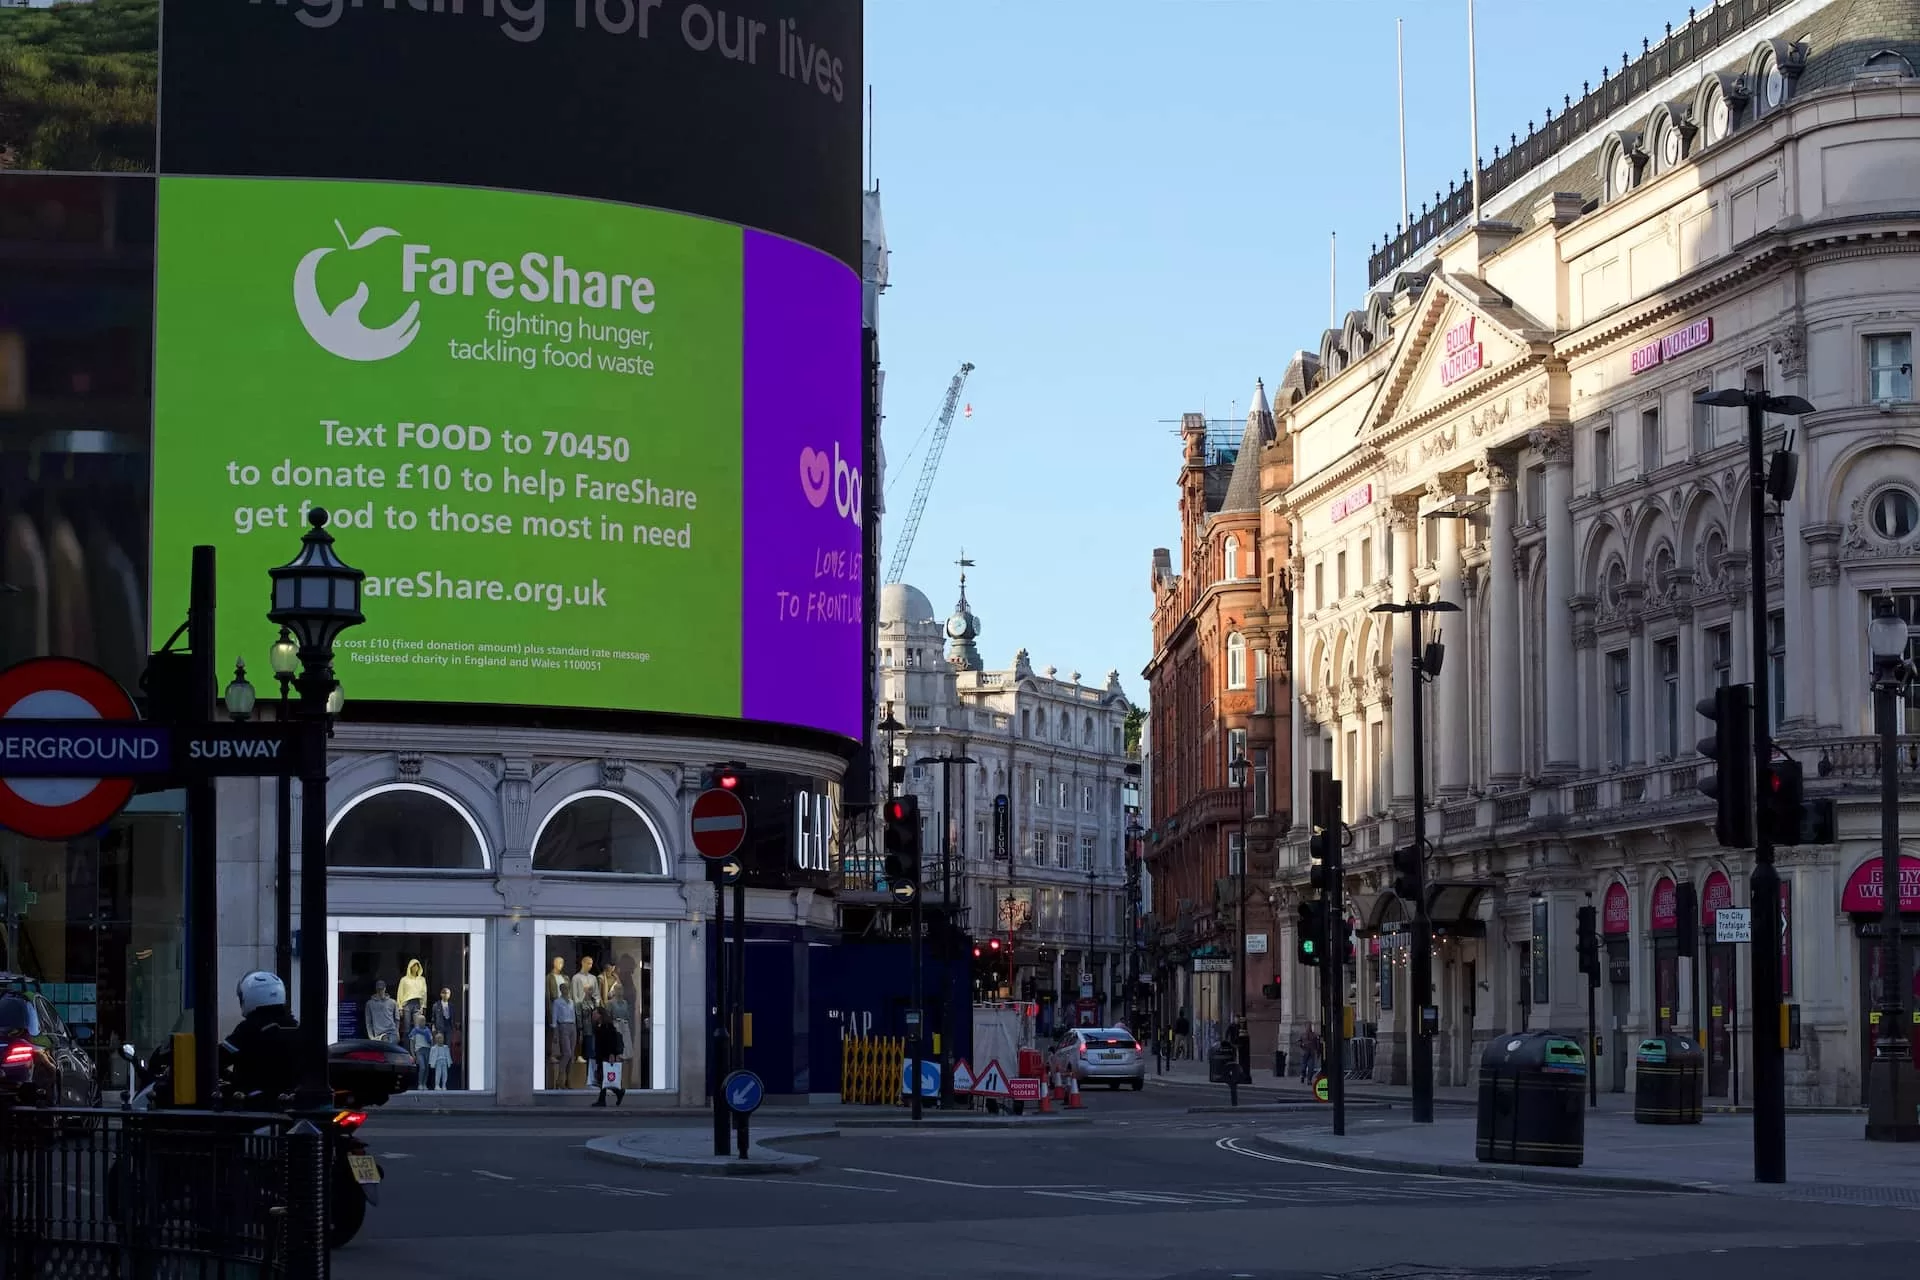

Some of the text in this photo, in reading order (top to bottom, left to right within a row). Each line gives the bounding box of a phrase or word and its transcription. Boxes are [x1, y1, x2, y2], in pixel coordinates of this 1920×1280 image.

[681, 3, 766, 64] our
[779, 17, 844, 103] lives
[402, 243, 656, 314] FareShare
[485, 308, 654, 351] fighting hunger,
[1446, 318, 1475, 355] BODY
[1630, 318, 1710, 374] BODY WORLDS
[449, 338, 655, 376] tackling food waste
[1440, 344, 1481, 384] WORLDS
[319, 420, 631, 462] Text FOOD to 70450
[226, 458, 698, 510] to donate £10 to help FareShare
[234, 503, 289, 534] get
[384, 505, 418, 530] to
[427, 504, 512, 535] those
[522, 515, 593, 540] most
[601, 514, 624, 542] in
[633, 522, 692, 549] need
[361, 570, 608, 611] areShare.org.uk
[776, 590, 801, 621] TO
[345, 639, 367, 649] cost
[369, 638, 390, 649] £10
[392, 638, 424, 651] (fixed
[426, 640, 473, 652] donation
[476, 642, 522, 654] amount)
[524, 644, 546, 656] plus
[547, 646, 590, 658] standard
[591, 649, 611, 660] rate
[612, 651, 651, 662] message
[350, 651, 602, 672] Registered charity in England and Wales 1100051
[0, 736, 283, 760] ERGROUND SUBWAY
[798, 789, 833, 872] GAP
[1859, 884, 1920, 898] WOLD
[1871, 870, 1920, 883] BDY
[1718, 911, 1744, 921] The City
[1718, 921, 1746, 930] Trafalgar
[1718, 932, 1750, 941] Hyde Park
